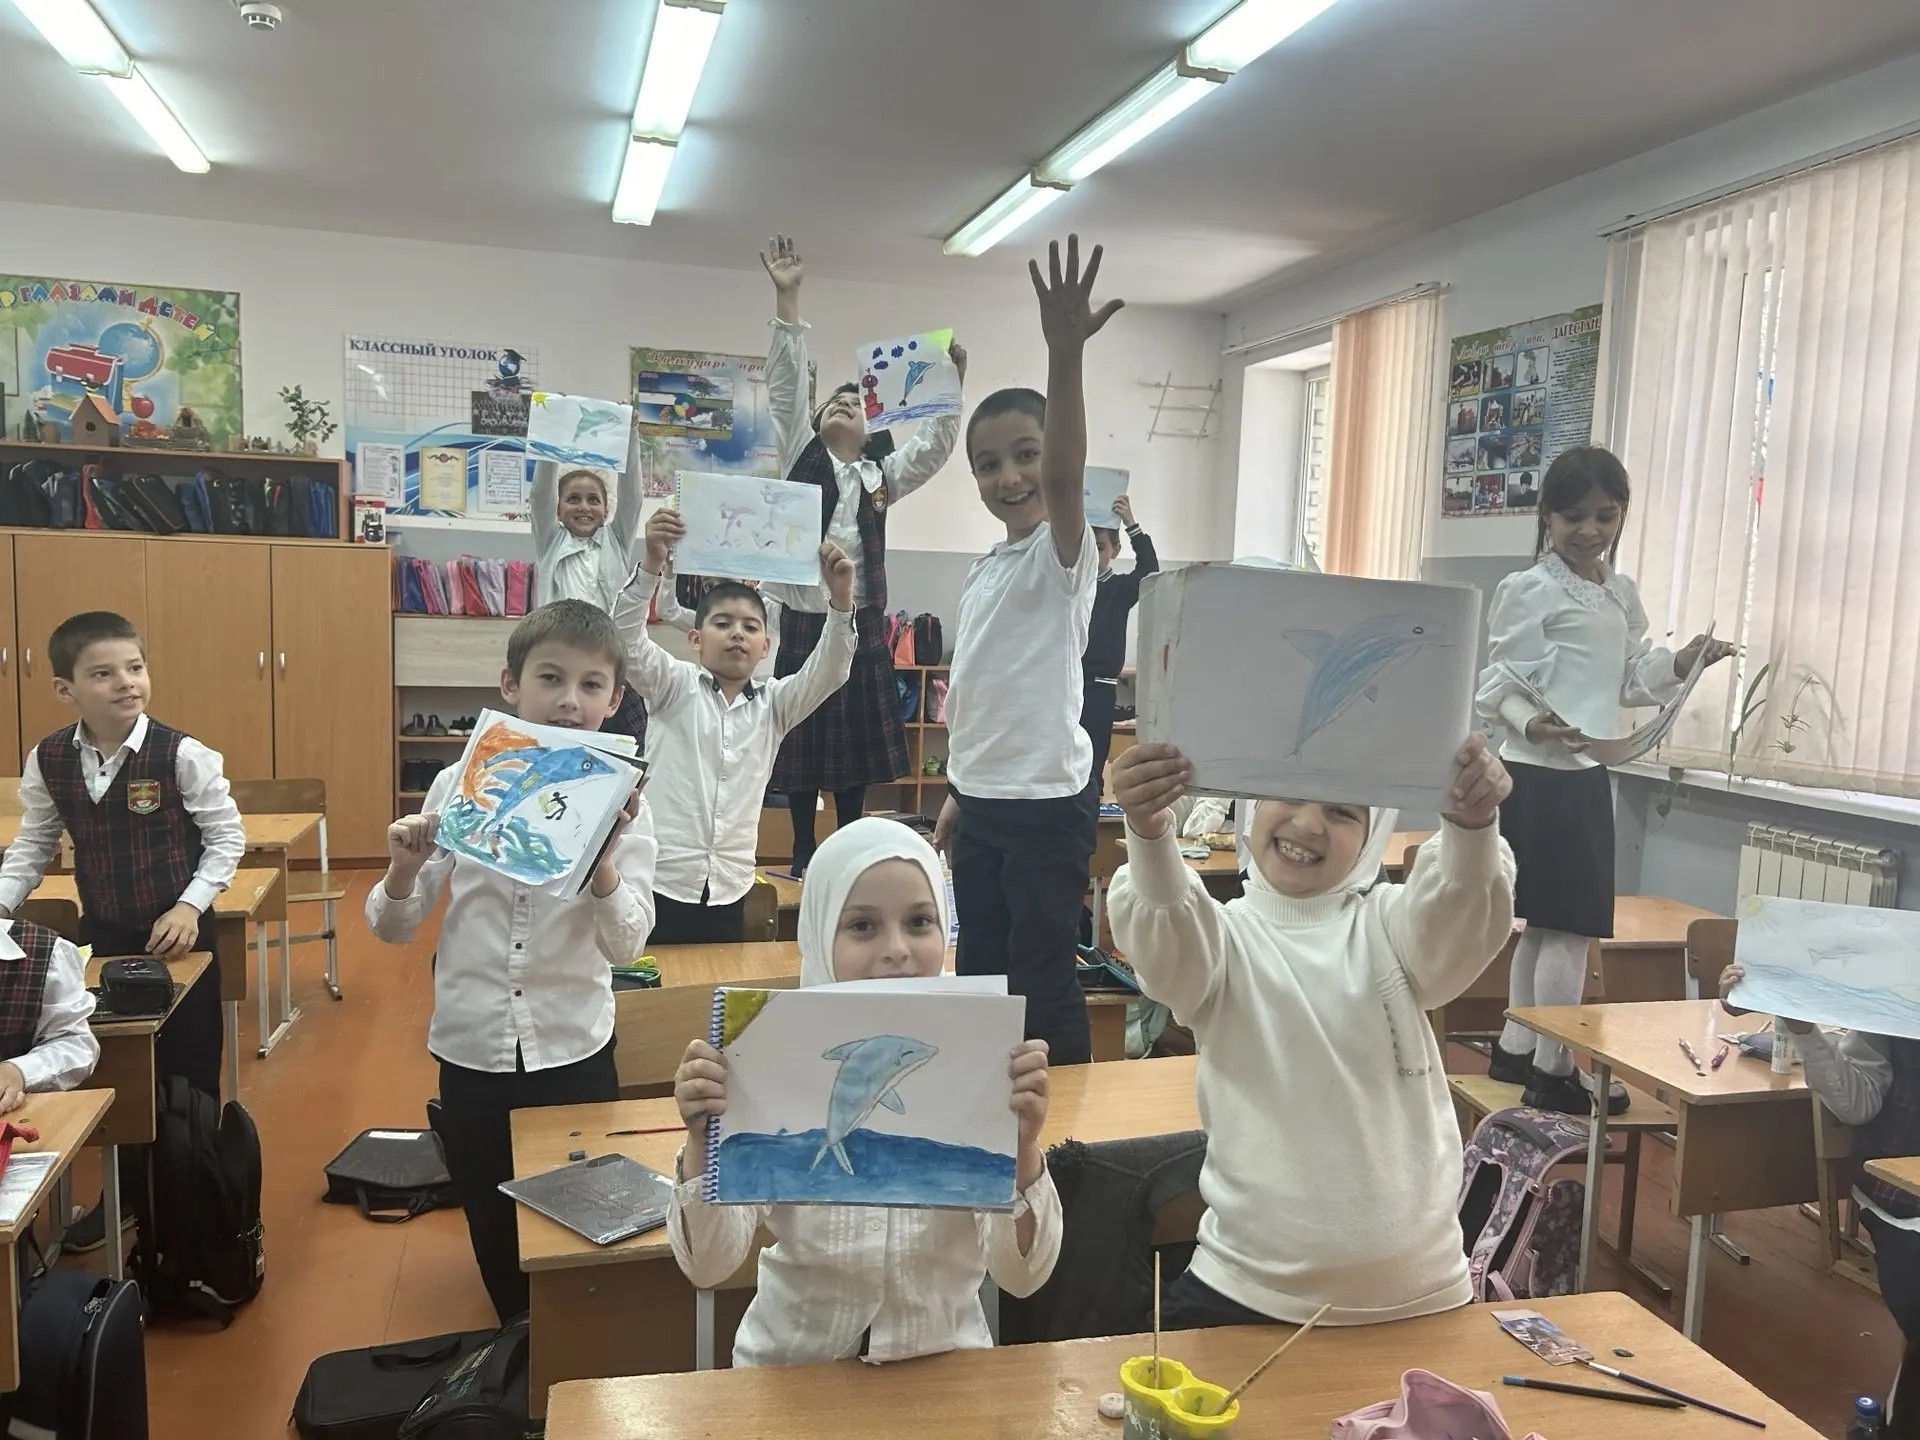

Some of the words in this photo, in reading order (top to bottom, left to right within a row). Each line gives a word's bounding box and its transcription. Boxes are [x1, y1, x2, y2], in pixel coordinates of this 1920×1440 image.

[19, 283, 136, 308] ГЛАЗАМИ
[138, 296, 215, 342] ДЕТЕЙ
[350, 339, 436, 357] КЛАССНЫЙ
[439, 346, 498, 361] УГОЛОК
